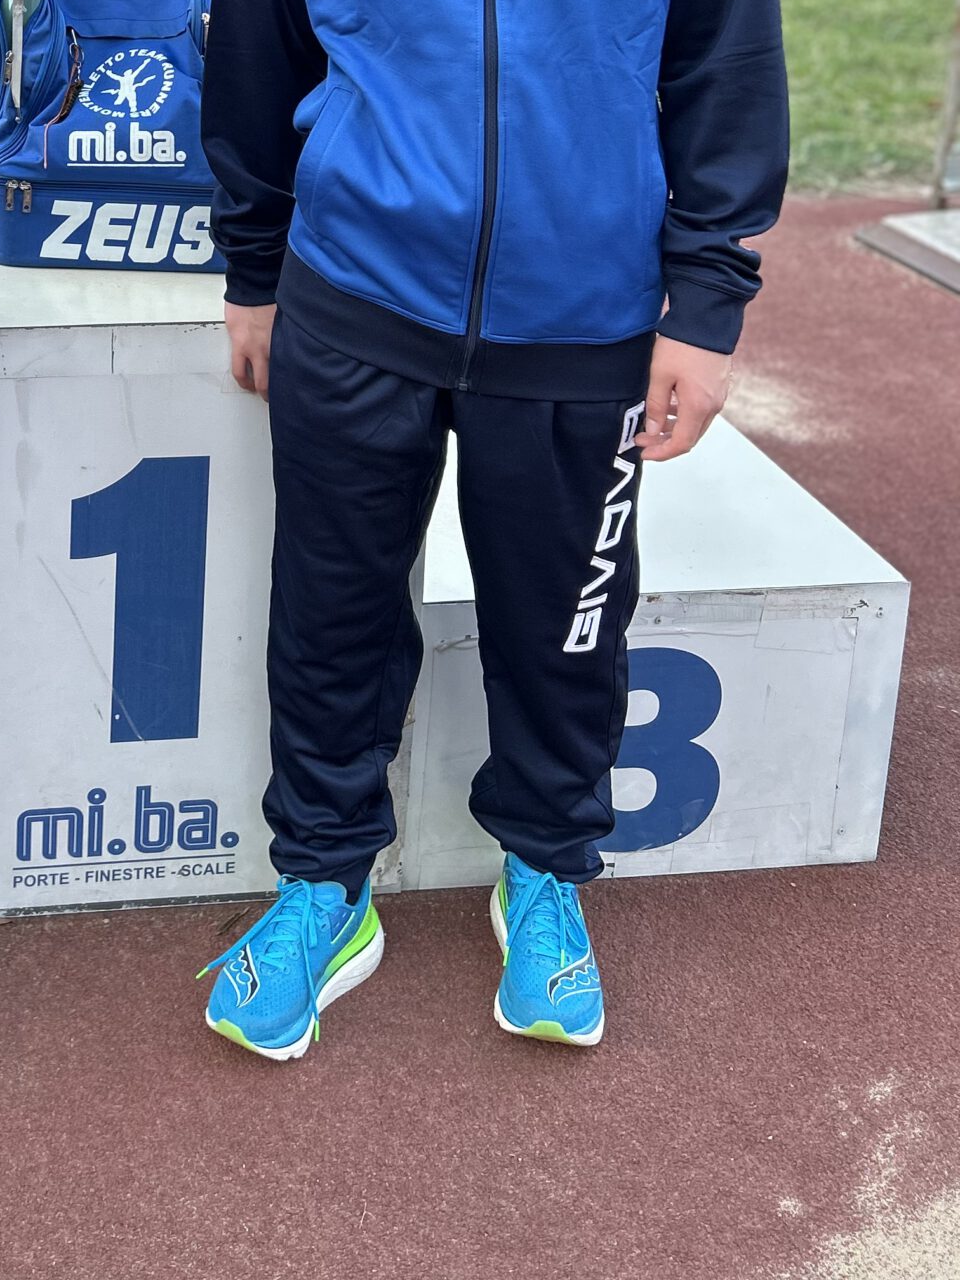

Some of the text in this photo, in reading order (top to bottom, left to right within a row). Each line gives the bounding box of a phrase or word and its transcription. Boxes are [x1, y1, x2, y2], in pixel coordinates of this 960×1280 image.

[78, 52, 125, 118] MONTEMILETTO
[129, 48, 167, 61] TEAM
[67, 122, 187, 162] mi.ba.
[40, 199, 215, 265] ZEUS
[563, 400, 645, 653] GIVOVA
[70, 456, 210, 743] 1
[16, 785, 240, 861] mi.ba.
[12, 872, 70, 888] PORTE
[85, 866, 166, 883] FINESTRE
[180, 862, 236, 878] SCALE
